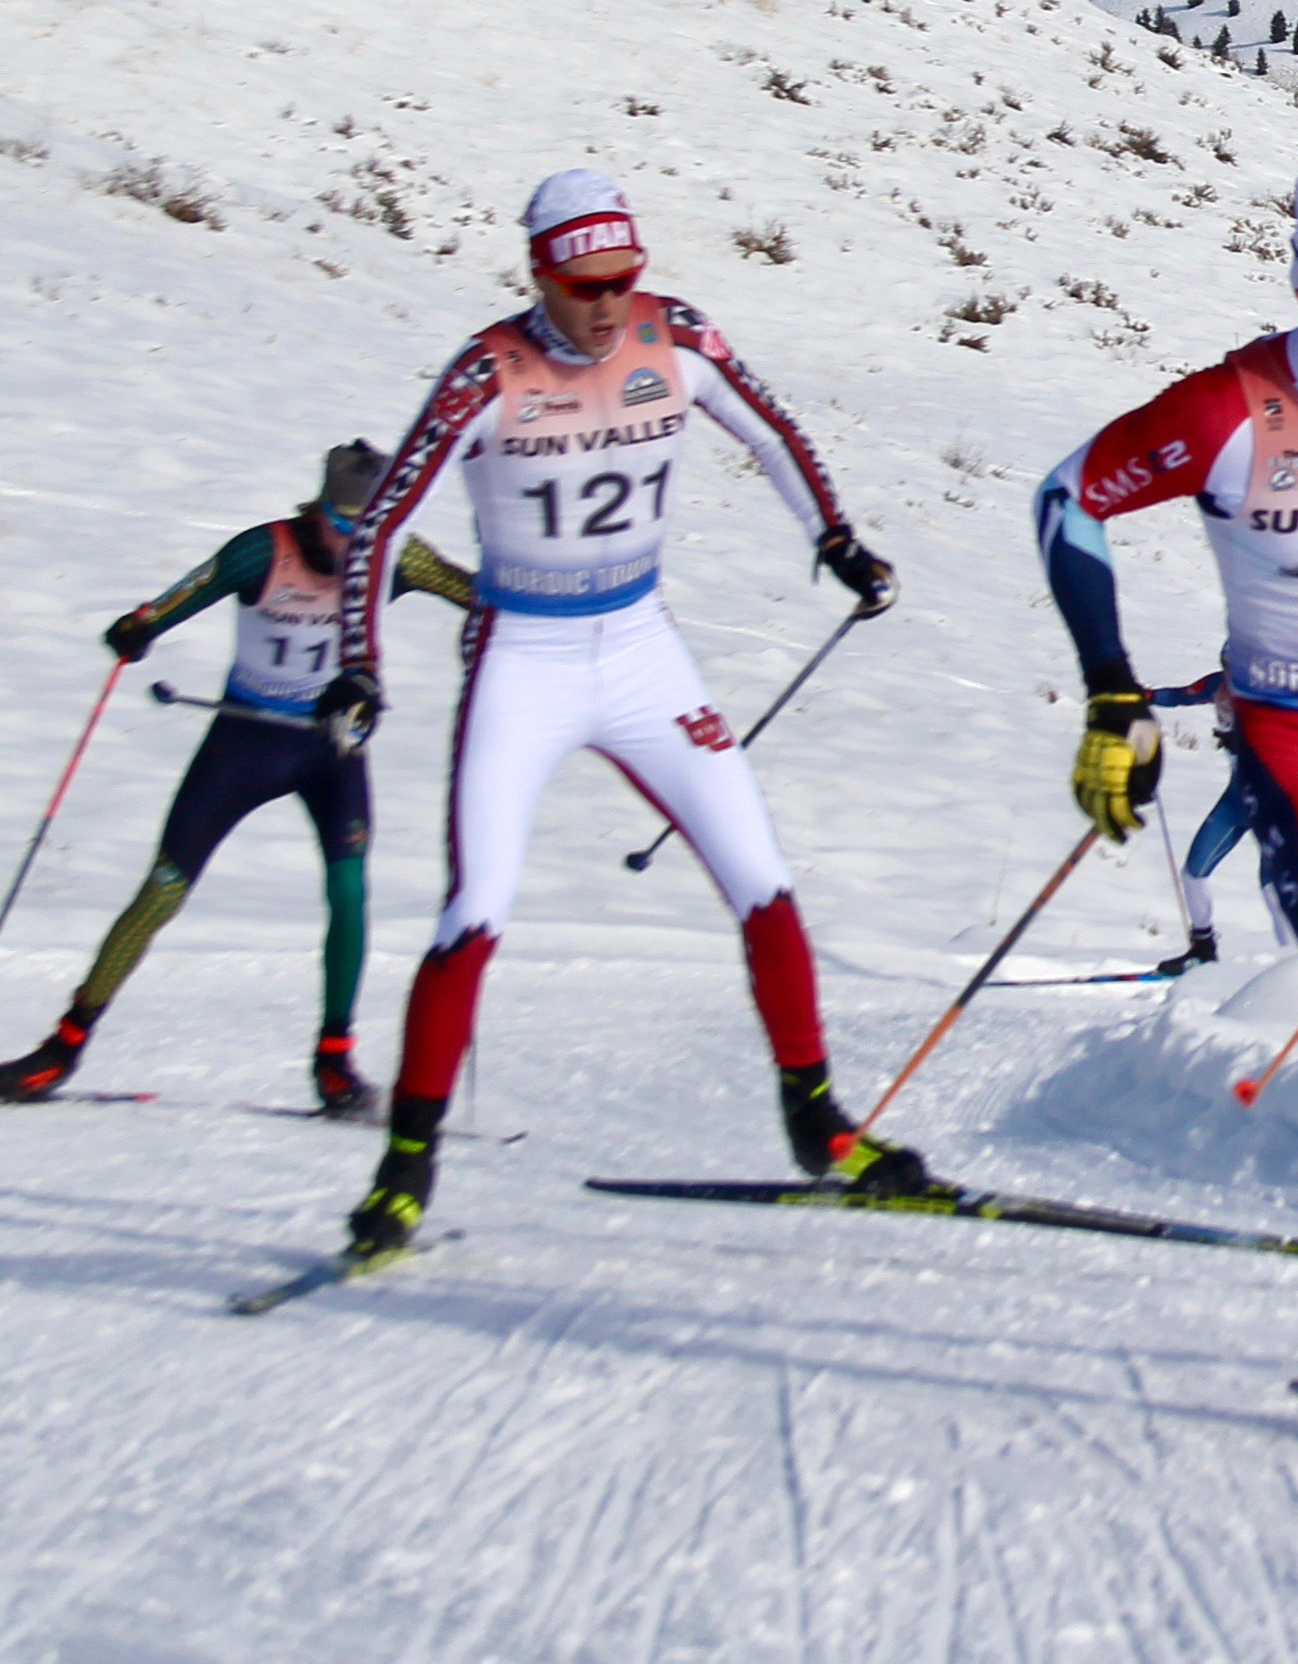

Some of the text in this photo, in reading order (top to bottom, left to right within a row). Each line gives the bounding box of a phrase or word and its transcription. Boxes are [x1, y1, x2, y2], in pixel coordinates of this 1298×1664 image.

[502, 434, 570, 457] SUN
[522, 459, 672, 538] 121
[1085, 456, 1153, 513] SMS
